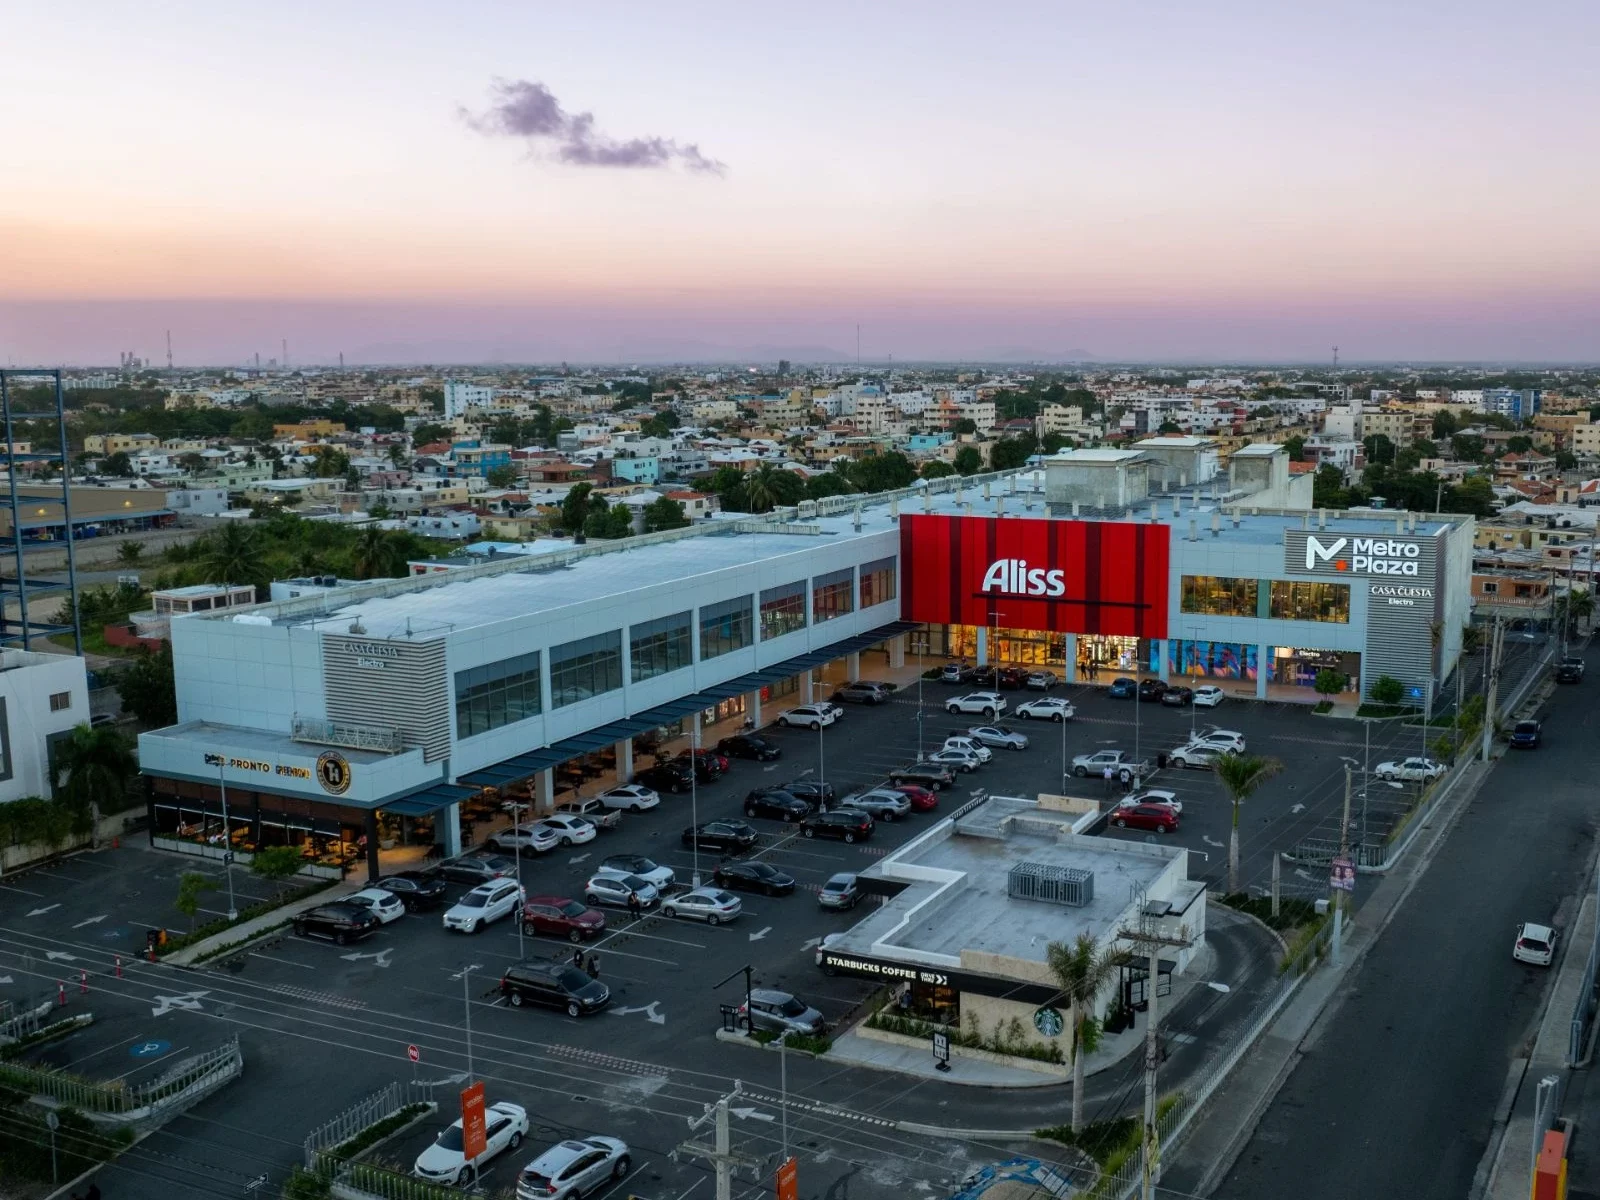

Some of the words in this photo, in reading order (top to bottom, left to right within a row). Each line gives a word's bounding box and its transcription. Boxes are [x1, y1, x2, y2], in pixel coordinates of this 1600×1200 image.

[1353, 538, 1420, 557] Metro
[1352, 556, 1418, 576] Plaza
[982, 558, 1066, 597] Aliss
[1371, 586, 1396, 596] CASA
[1388, 597, 1414, 606] Electro
[343, 642, 366, 655] CASA
[1298, 650, 1321, 658] Electro
[357, 657, 385, 668] Electro
[230, 757, 271, 773] PRONTO
[826, 957, 880, 973] STARBUCKS
[881, 966, 917, 979] COFFEE
